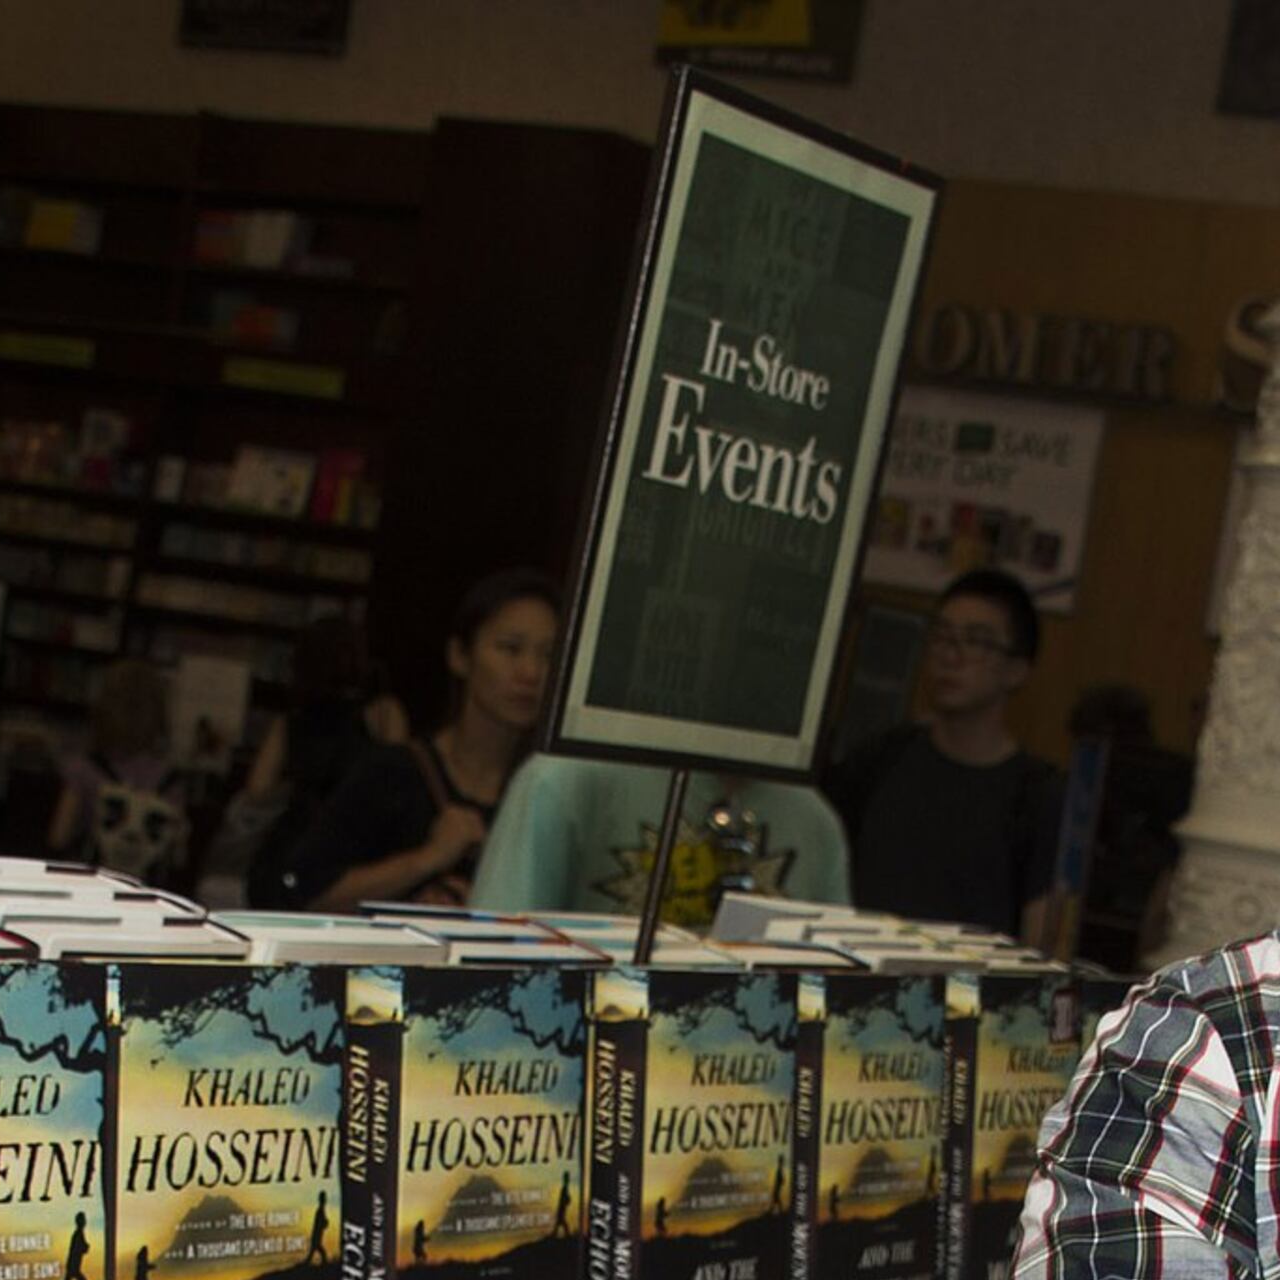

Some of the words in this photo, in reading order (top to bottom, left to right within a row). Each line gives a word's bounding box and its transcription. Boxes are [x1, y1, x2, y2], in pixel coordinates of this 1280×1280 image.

[700, 318, 830, 412] In-Store
[918, 300, 1178, 402] OMER
[642, 373, 843, 524] Events
[183, 1065, 311, 1108] KHALED
[346, 1043, 369, 1184] HOSSEINI
[453, 1059, 559, 1097] KHALED
[593, 1038, 616, 1165] HOSSEINI
[125, 1125, 340, 1193] HOSSEINI
[404, 1113, 581, 1173] HOSSEINI
